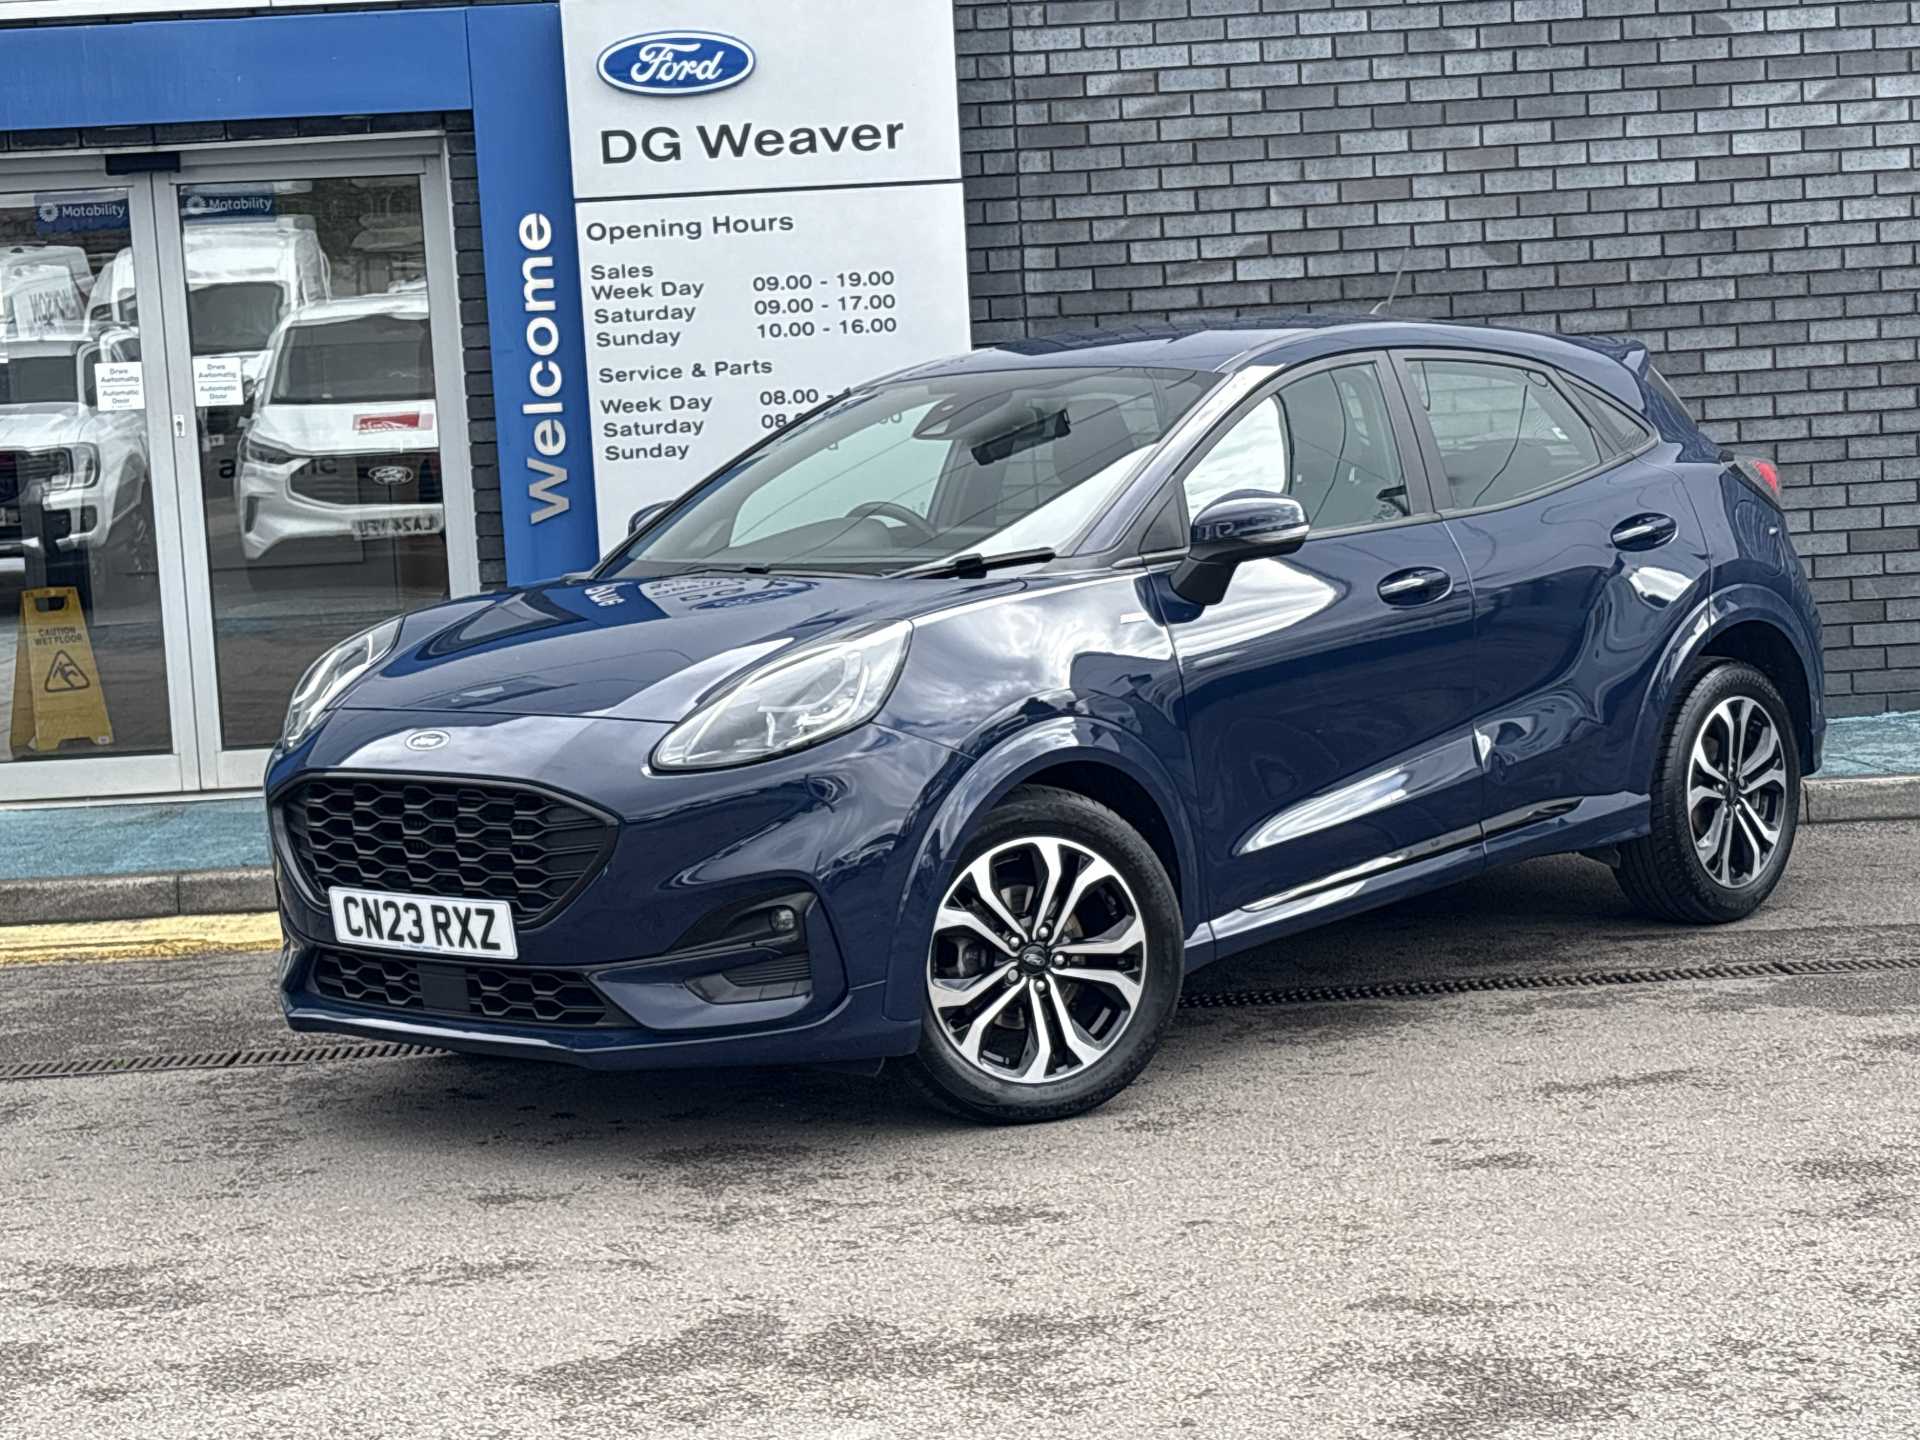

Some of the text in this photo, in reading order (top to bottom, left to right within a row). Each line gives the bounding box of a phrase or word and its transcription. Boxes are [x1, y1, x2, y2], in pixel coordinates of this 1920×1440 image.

[630, 42, 725, 82] Ford
[600, 122, 904, 164] DG Weaver
[61, 204, 126, 218] Motability
[208, 197, 273, 211] Motability
[585, 215, 794, 245] Opening Hours
[590, 263, 654, 280] Sales
[591, 282, 654, 301] Week
[660, 280, 705, 299] Day
[752, 274, 813, 292] 09.00
[836, 270, 895, 288] 19.00
[594, 304, 697, 325] Saturday
[754, 298, 814, 315] 09.00
[837, 294, 896, 312] 17.00
[595, 329, 681, 348] Sunday
[756, 321, 815, 339] 10.00
[839, 317, 897, 335] 16.00
[518, 212, 570, 525] Welcome
[598, 359, 773, 384] Service & Parts
[599, 396, 662, 415] Week
[669, 394, 713, 413] Day
[759, 388, 819, 406] 08.00
[603, 418, 705, 438] Saturday
[604, 442, 690, 462] Sunday
[343, 896, 501, 950] CN23 RXZ
